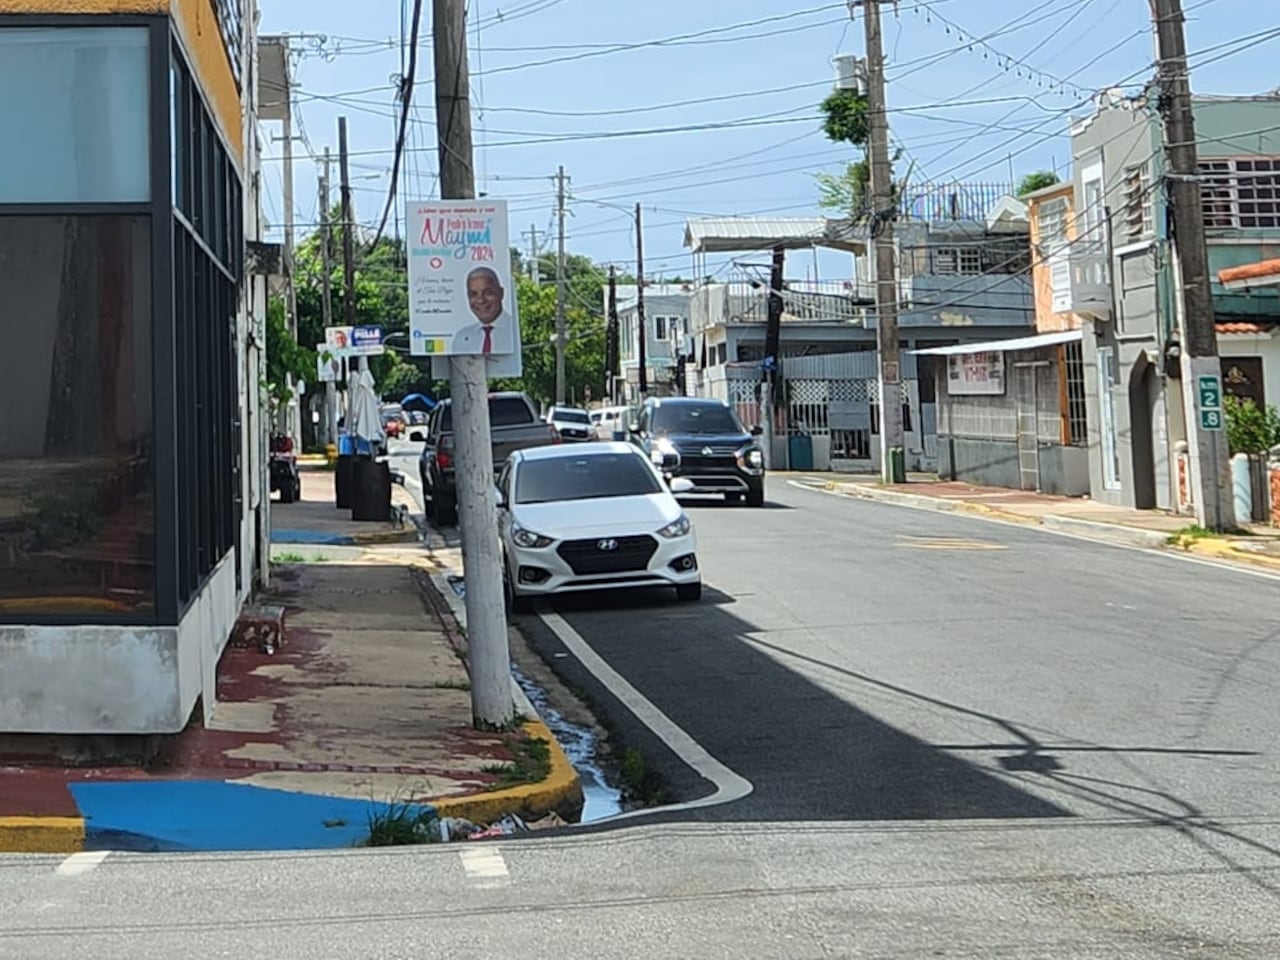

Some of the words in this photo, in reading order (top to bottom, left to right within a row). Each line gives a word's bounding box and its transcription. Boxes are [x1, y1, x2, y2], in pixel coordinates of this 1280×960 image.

[471, 246, 494, 261] 2024
[1200, 381, 1217, 390] km
[1204, 392, 1216, 406] 2
